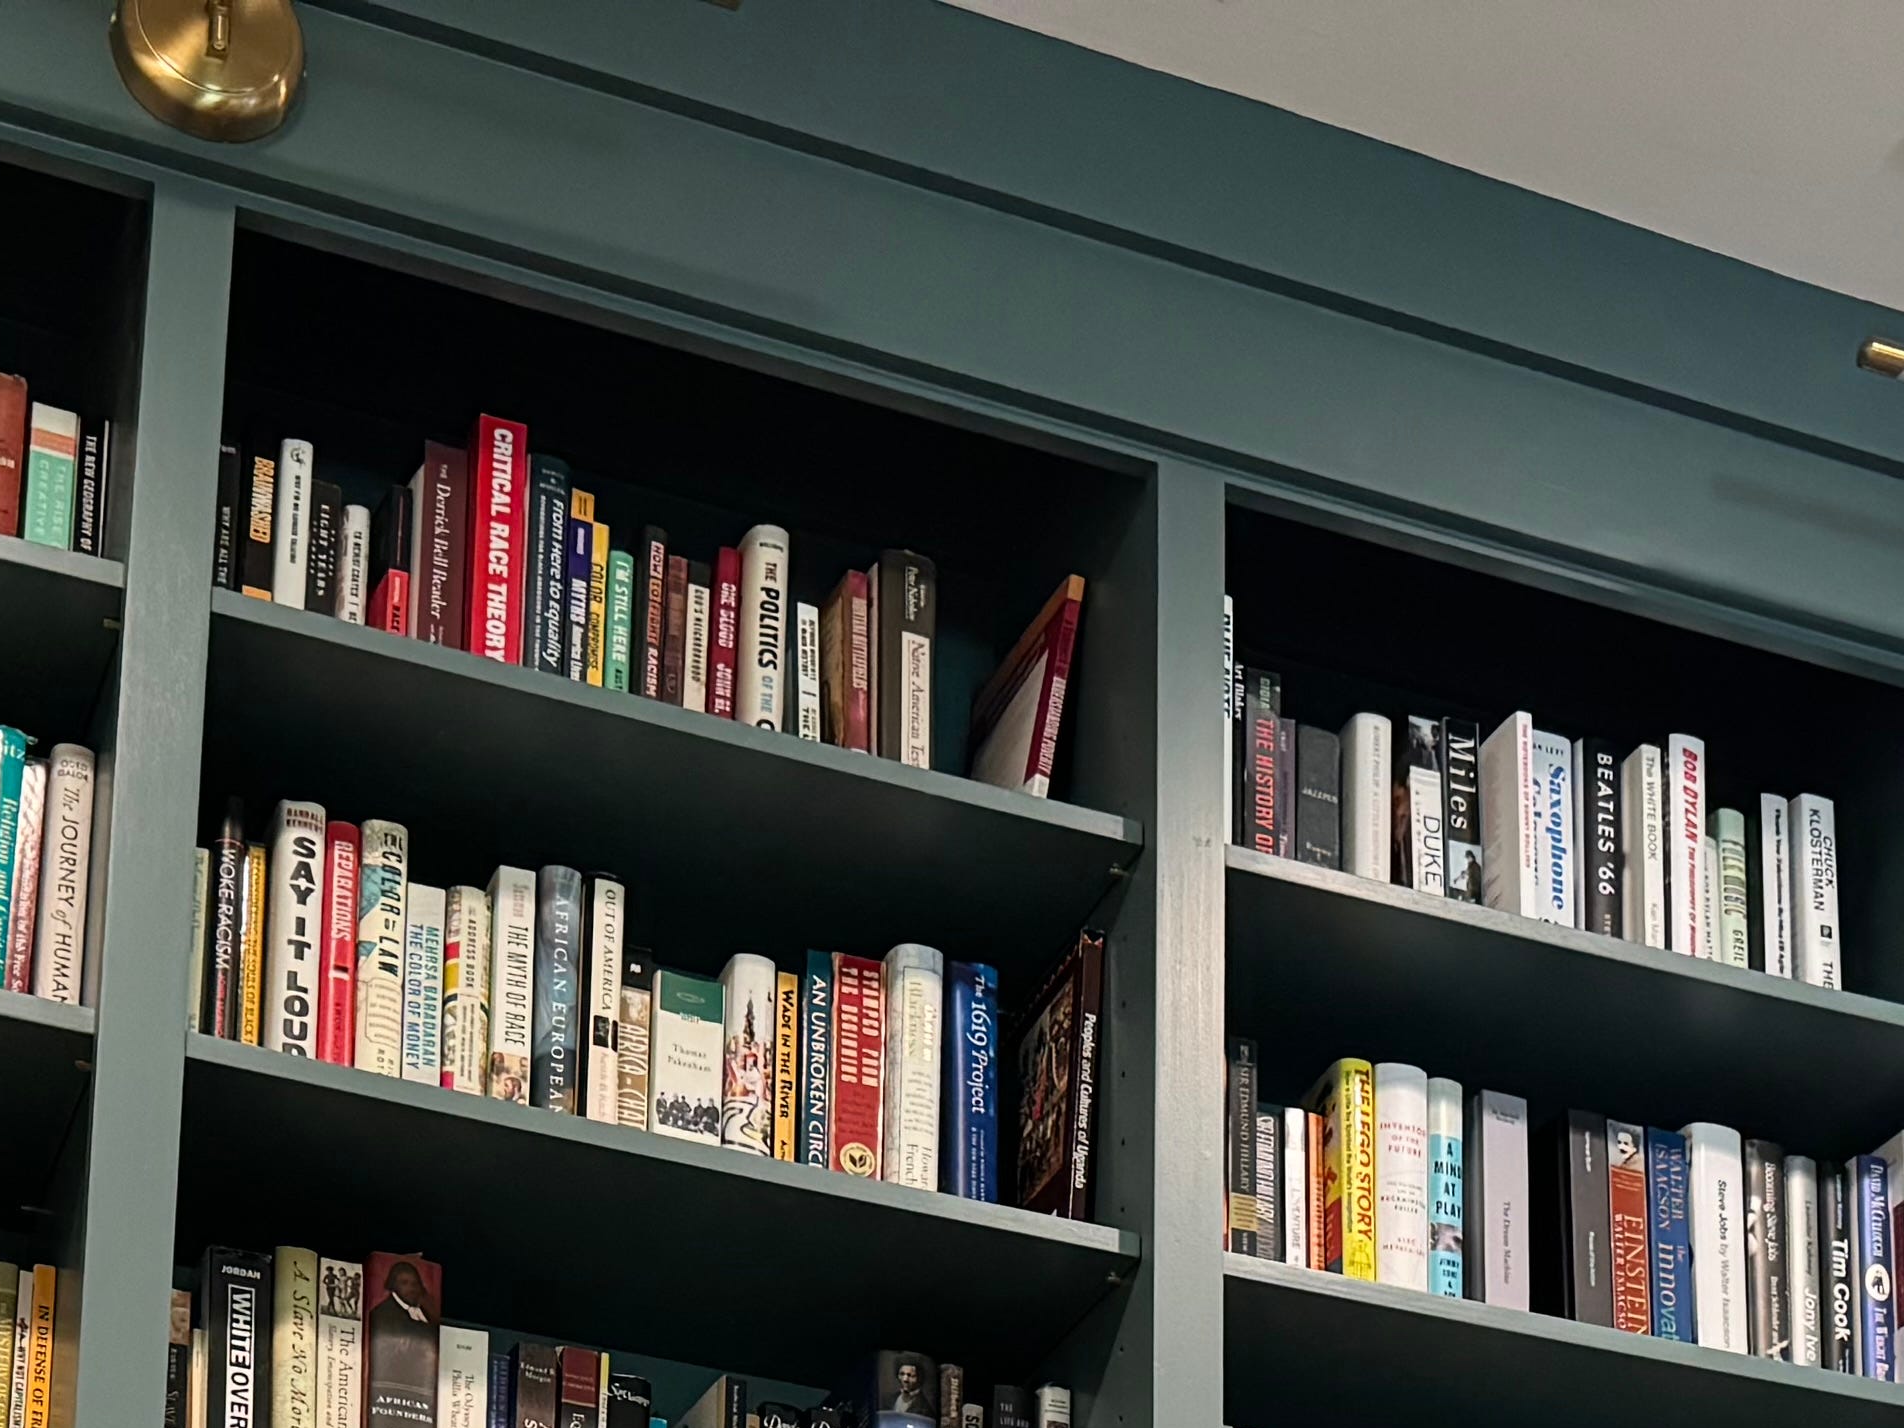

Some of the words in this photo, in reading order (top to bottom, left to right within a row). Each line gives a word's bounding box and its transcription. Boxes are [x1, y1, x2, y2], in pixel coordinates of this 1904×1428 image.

[490, 428, 515, 518] CRITICAL
[488, 522, 509, 580] RACE
[484, 582, 509, 663] THEORY
[756, 586, 781, 670] POLITICS
[1448, 734, 1475, 833] Miles
[1597, 754, 1616, 856] BEATLES
[53, 815, 80, 906] JOURNEY
[291, 836, 316, 906] SAY
[1421, 815, 1442, 889] DUKE
[1597, 858, 1615, 896] '66
[288, 917, 311, 960] IT
[969, 1002, 989, 1043] 1619
[972, 1047, 989, 1113] Project
[221, 1264, 261, 1279] JORDAN
[1832, 1239, 1848, 1278] Tim
[228, 1294, 251, 1365] WHITE
[1834, 1284, 1849, 1341] Cook
[228, 1370, 250, 1428] OVER
